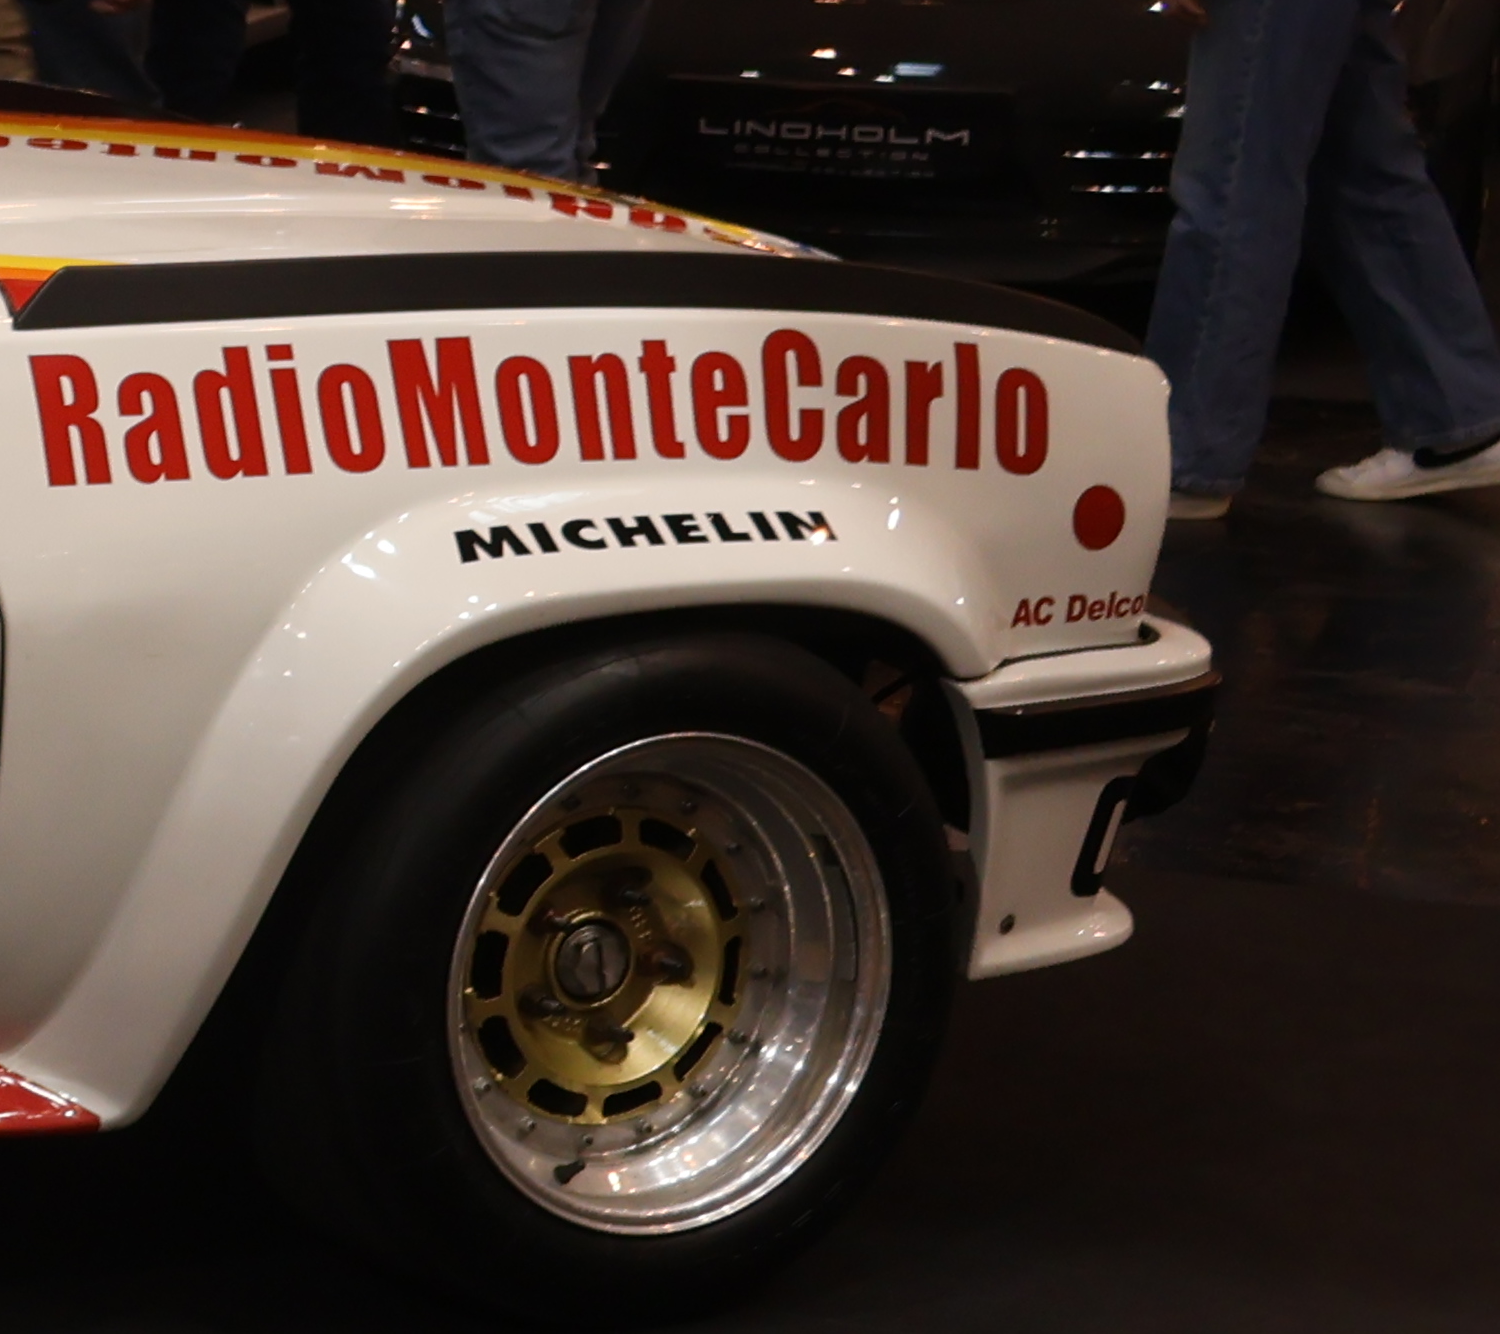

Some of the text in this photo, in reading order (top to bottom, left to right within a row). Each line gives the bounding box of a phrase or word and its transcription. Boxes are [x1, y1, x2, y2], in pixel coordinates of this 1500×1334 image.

[699, 117, 971, 147] LINDHOLM
[27, 328, 1051, 489] RadioMonteCarlo
[454, 509, 838, 565] MICHELIN
[1010, 589, 1145, 629] AC Delco
